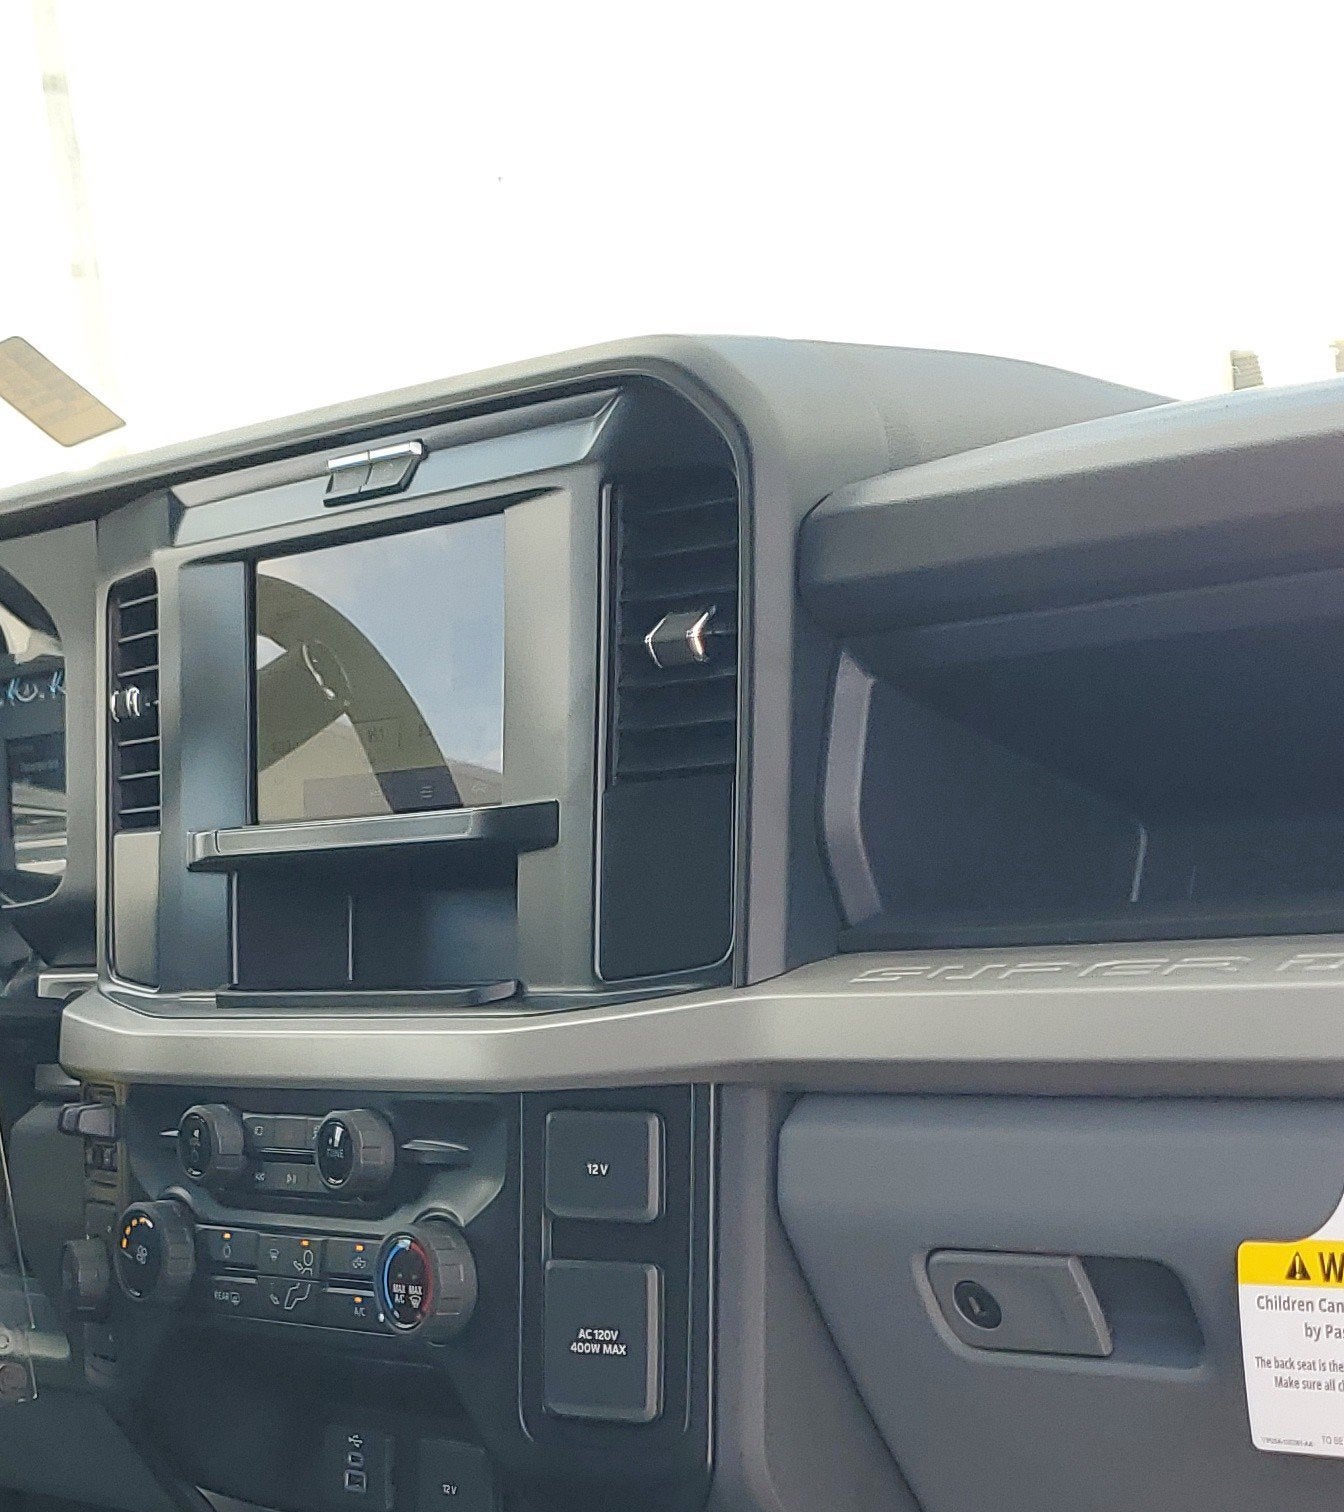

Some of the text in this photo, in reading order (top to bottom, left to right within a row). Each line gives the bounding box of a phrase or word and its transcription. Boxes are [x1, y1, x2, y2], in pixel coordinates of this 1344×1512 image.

[848, 955, 1254, 984] SUPER
[1256, 1295, 1314, 1312] Children
[1318, 1298, 1344, 1313] Can
[578, 1328, 619, 1341] AC 120V
[1304, 1322, 1321, 1342] by
[570, 1342, 627, 1356] 400W MAX
[1255, 1356, 1272, 1369] The
[1274, 1356, 1295, 1370] back
[1297, 1359, 1317, 1372] seat
[1318, 1359, 1326, 1372] is
[1328, 1360, 1344, 1373] the
[1274, 1375, 1300, 1390] Make
[1301, 1379, 1322, 1391] sure
[1324, 1378, 1336, 1391] all
